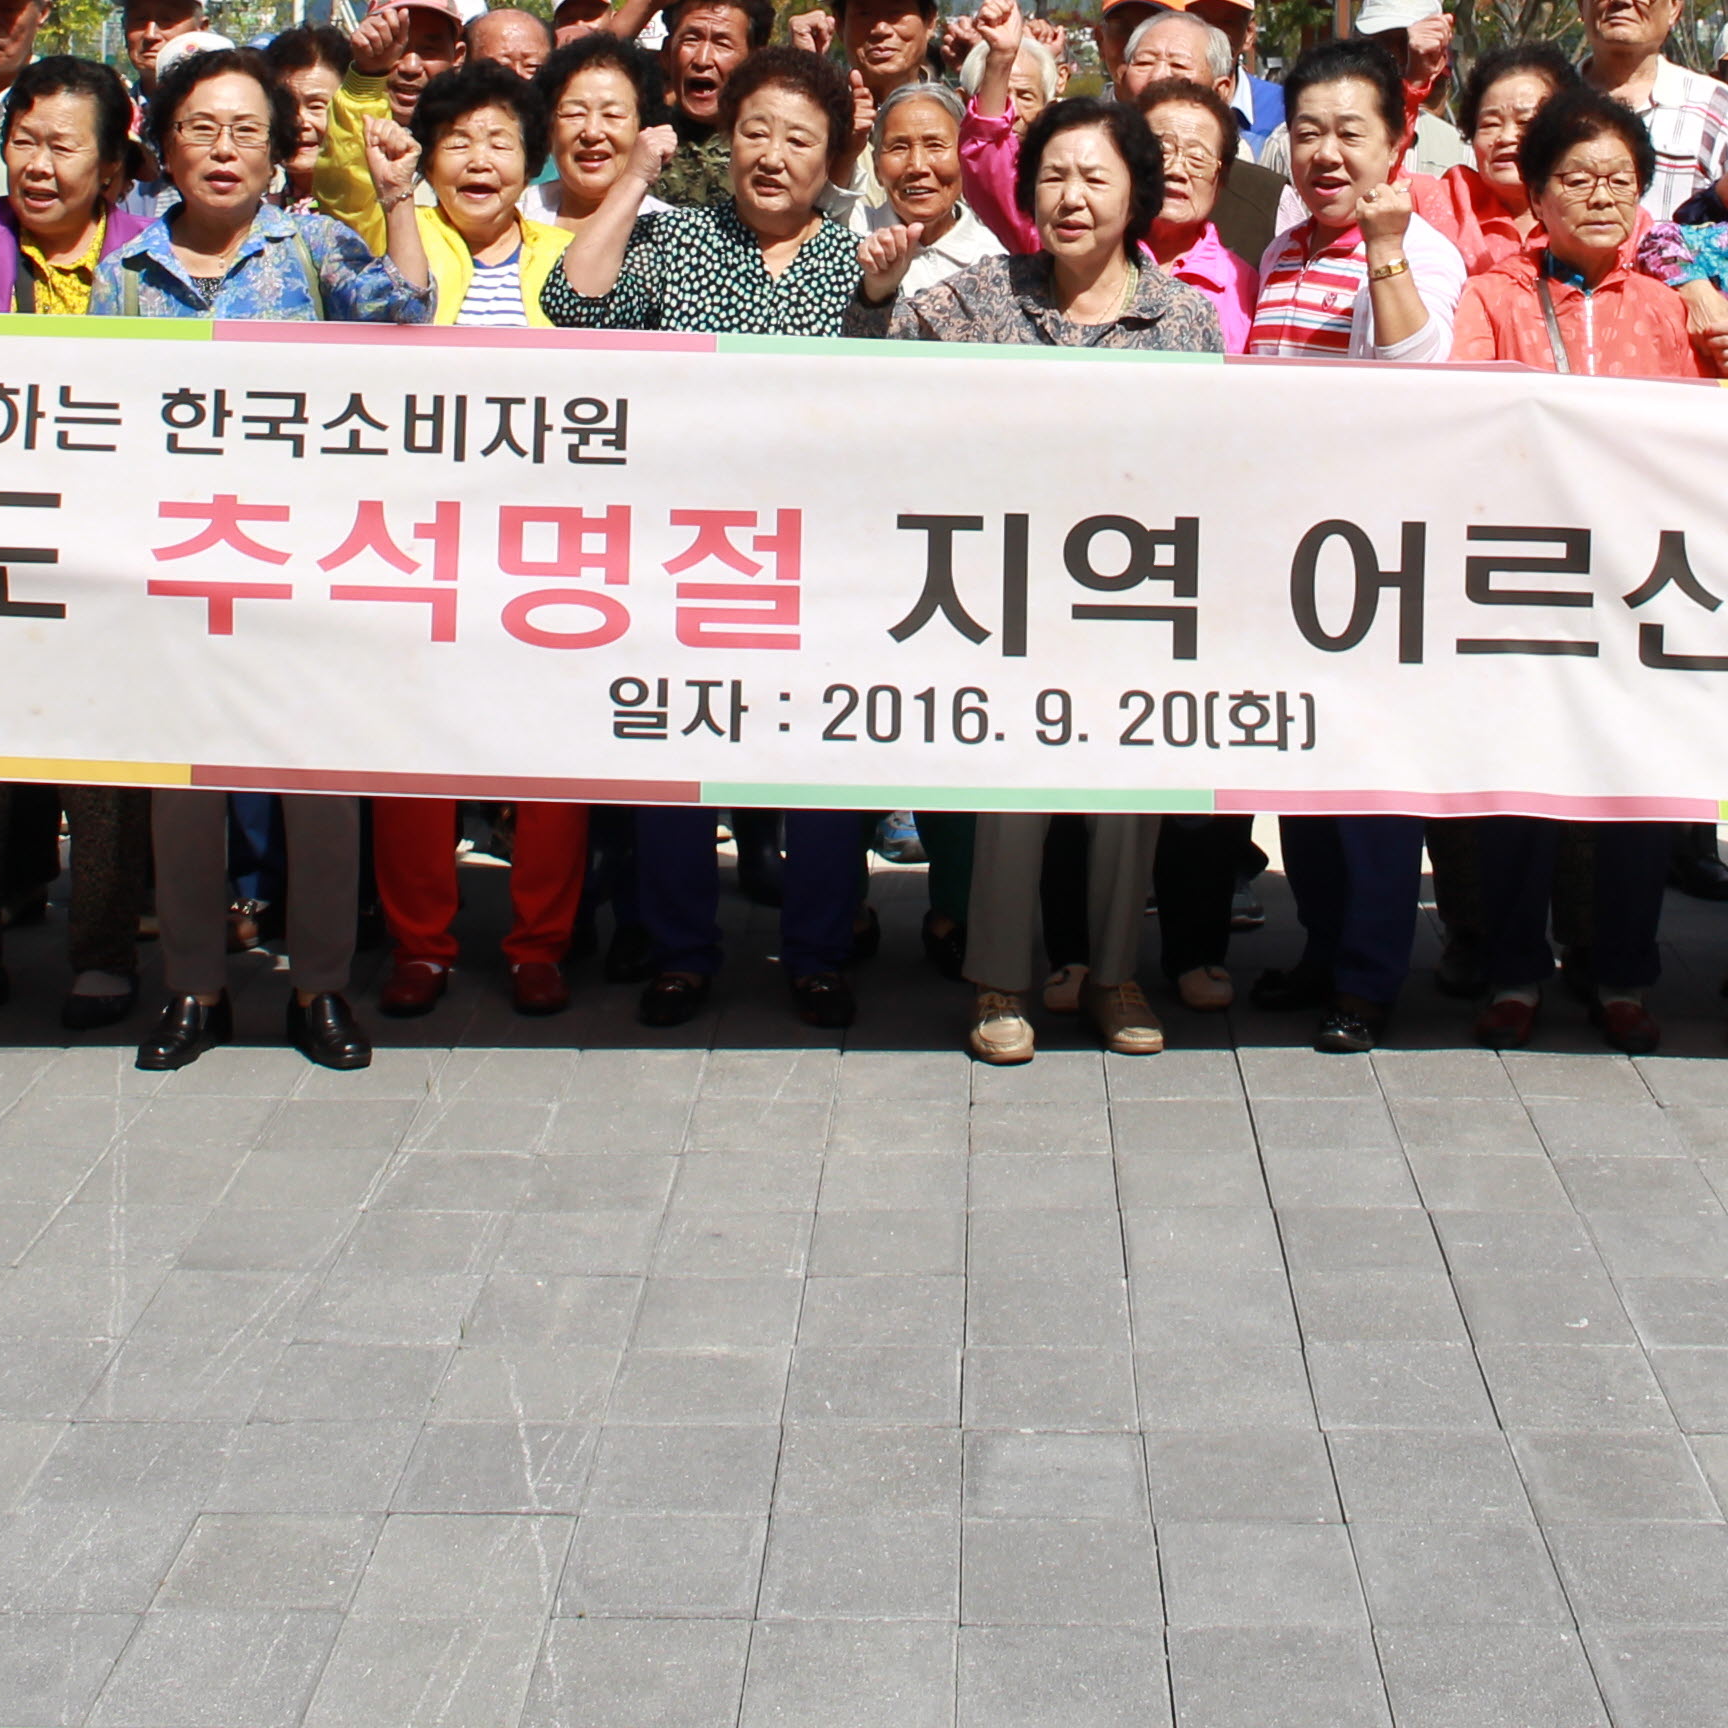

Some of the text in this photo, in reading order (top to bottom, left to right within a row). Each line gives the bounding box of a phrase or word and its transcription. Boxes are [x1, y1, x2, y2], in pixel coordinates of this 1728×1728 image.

[161, 387, 629, 466] 한국소비자원
[147, 494, 803, 651] 추석명절
[887, 512, 1201, 661] 지역
[609, 676, 749, 743] 일자
[822, 683, 1006, 745] 2016.
[1035, 688, 1090, 746] 9.
[1118, 689, 1317, 752] 20(화)
